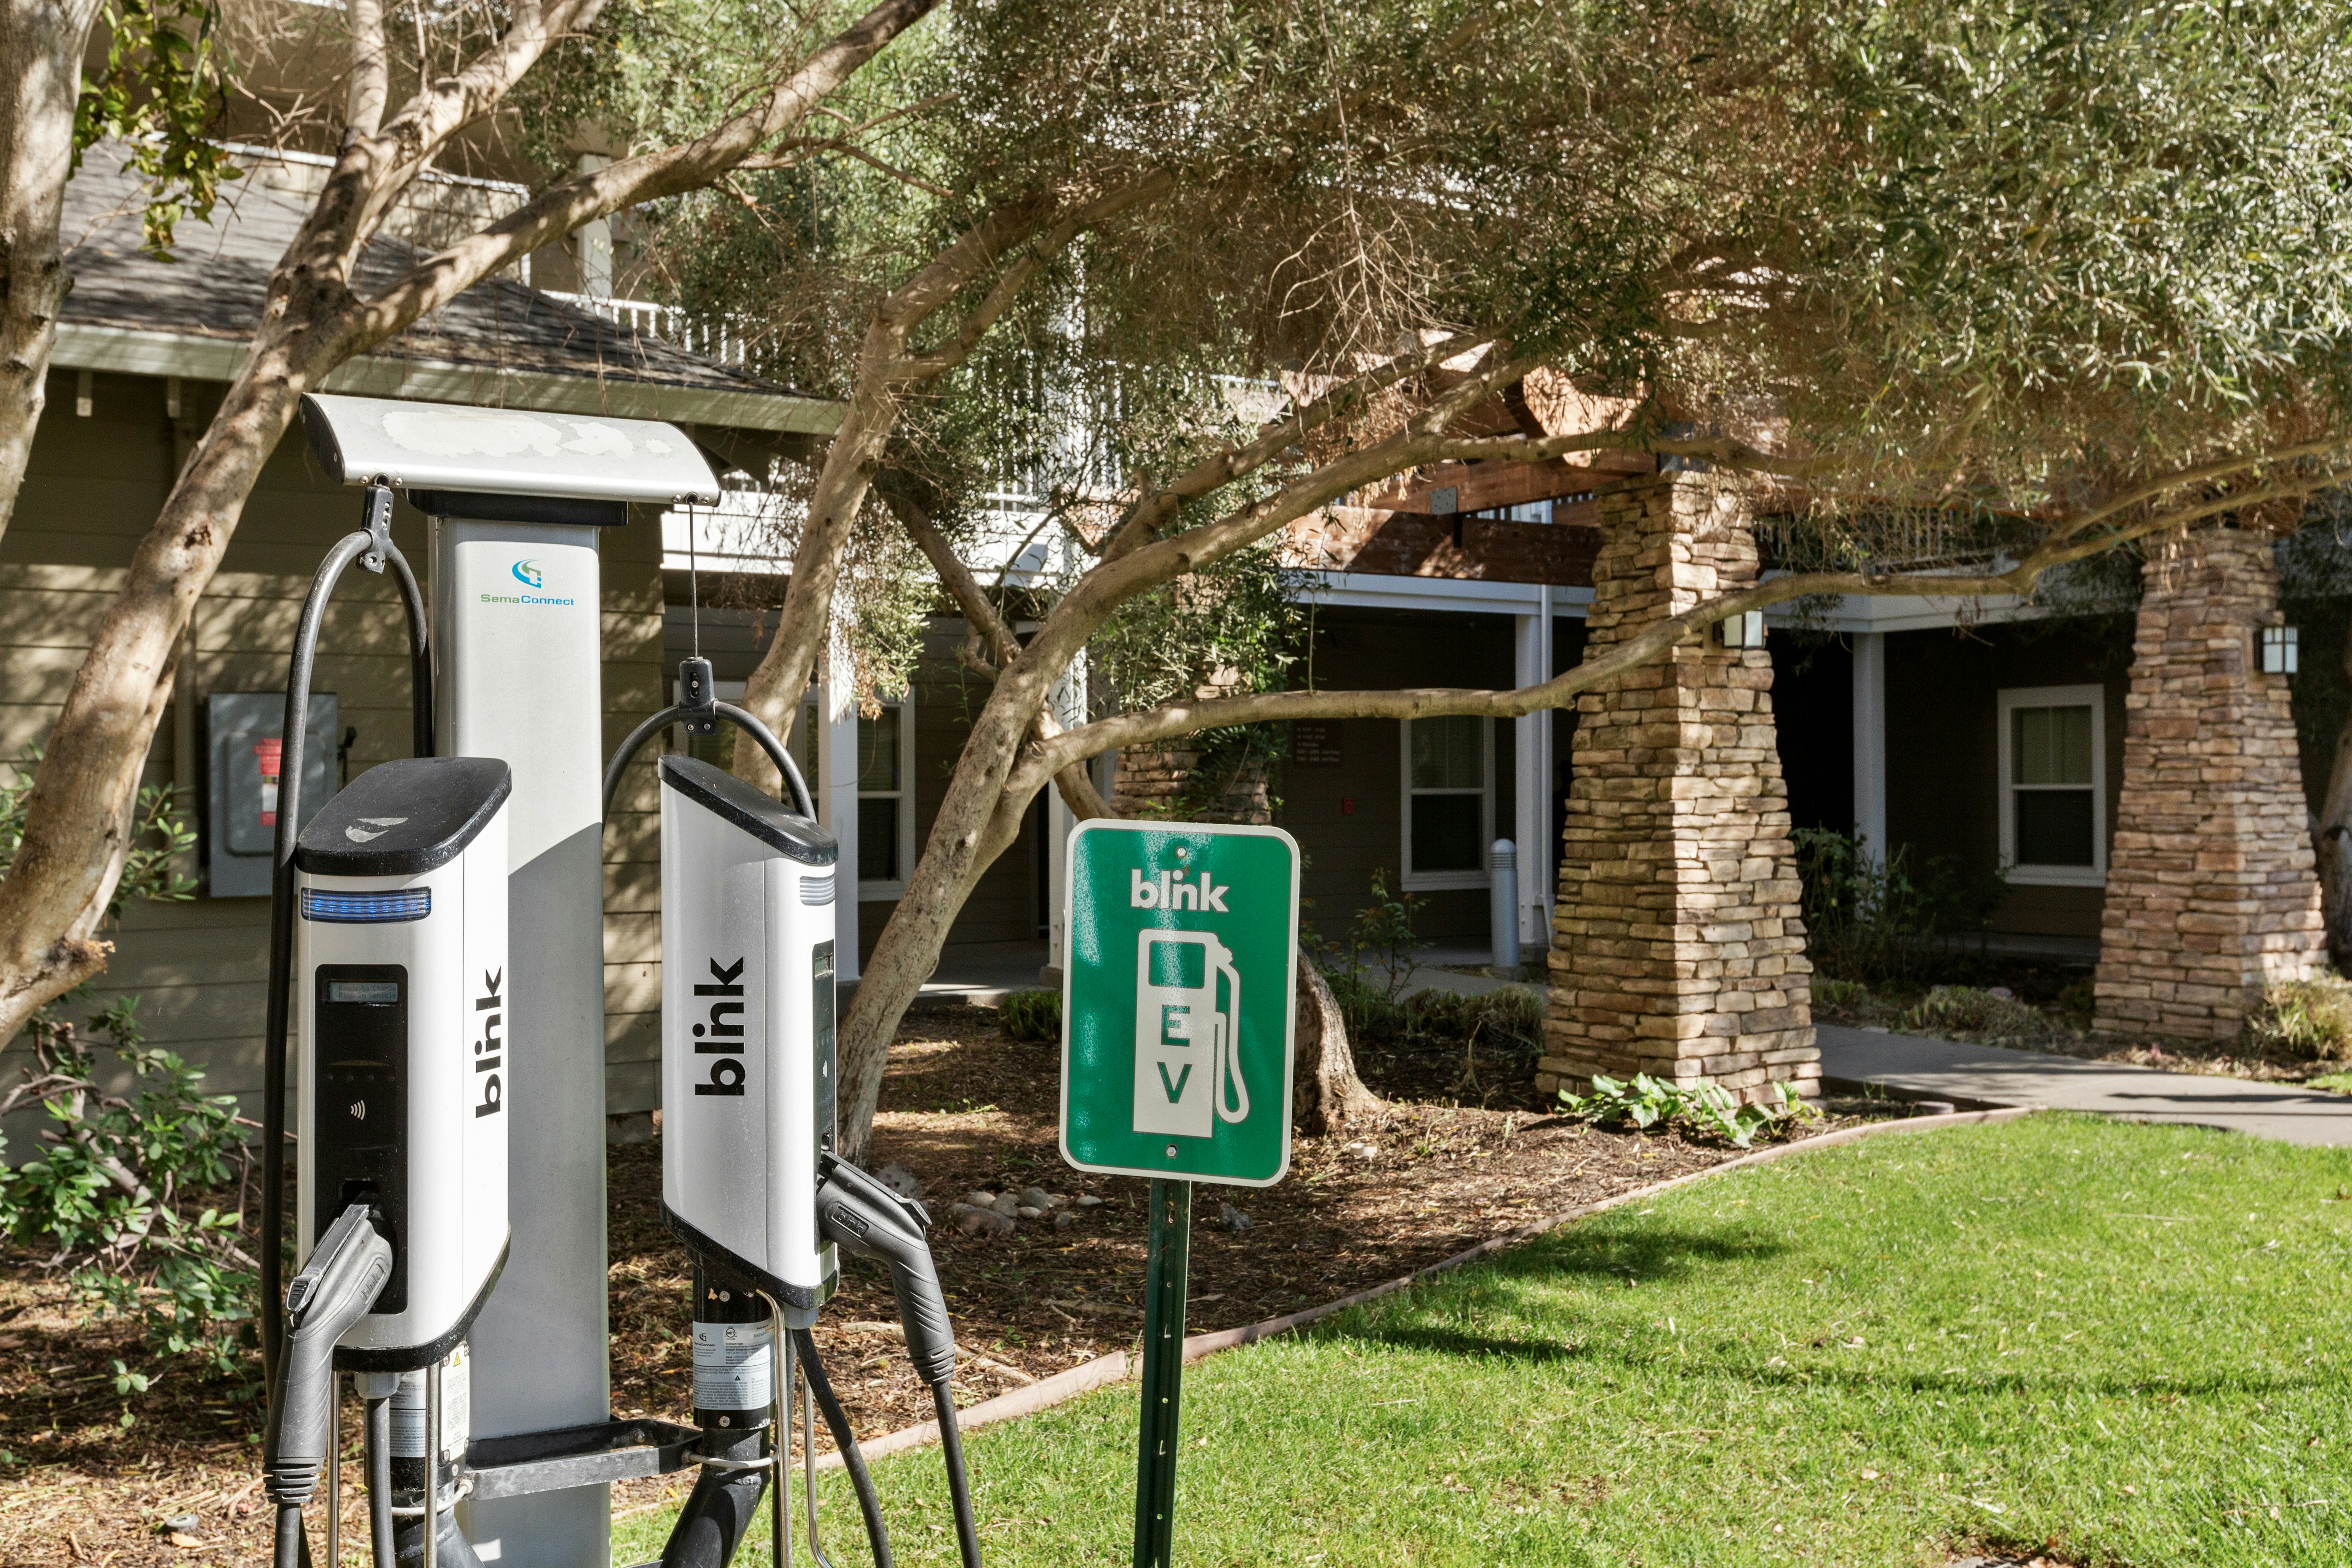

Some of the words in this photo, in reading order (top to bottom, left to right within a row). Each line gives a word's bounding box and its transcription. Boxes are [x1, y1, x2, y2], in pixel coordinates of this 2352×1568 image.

[480, 594, 574, 605] SemaConnect
[1130, 867, 1230, 913] blink
[474, 965, 501, 1118] blink
[692, 956, 746, 1096] blink
[838, 1209, 863, 1235] blink
